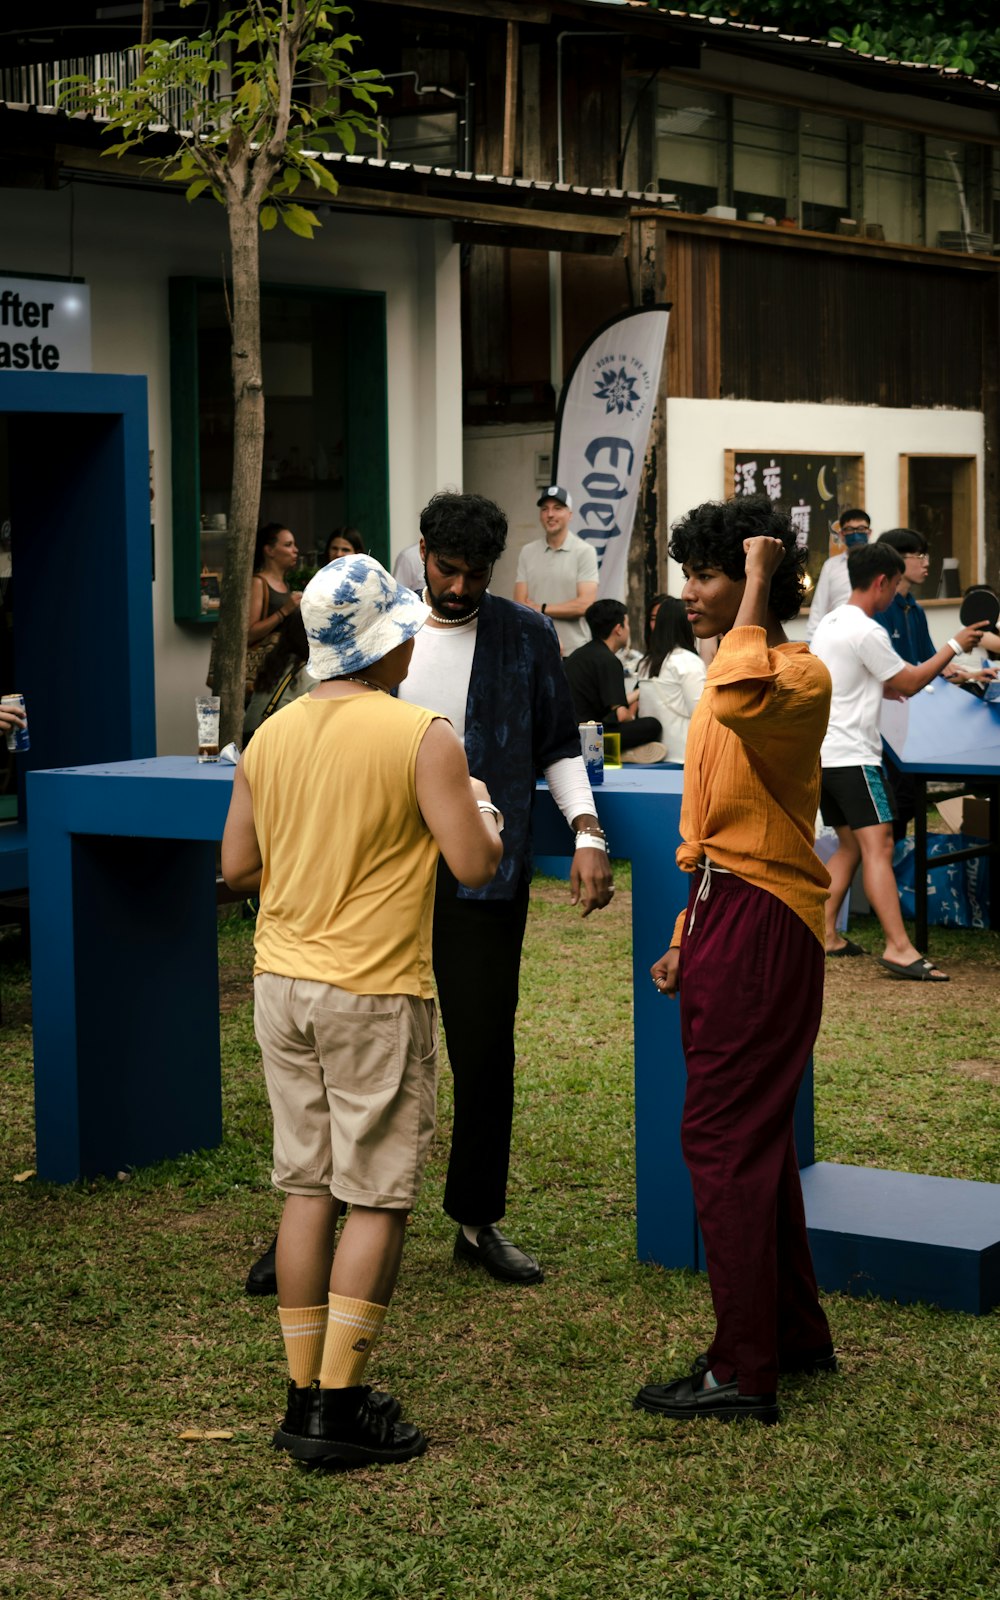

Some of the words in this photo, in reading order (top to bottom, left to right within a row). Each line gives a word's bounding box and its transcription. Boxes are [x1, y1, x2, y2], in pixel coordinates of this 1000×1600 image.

[0, 290, 55, 328] fter
[596, 355, 615, 368] BORN
[618, 354, 626, 362] IN
[631, 357, 643, 370] THE
[577, 437, 634, 571] Edel
